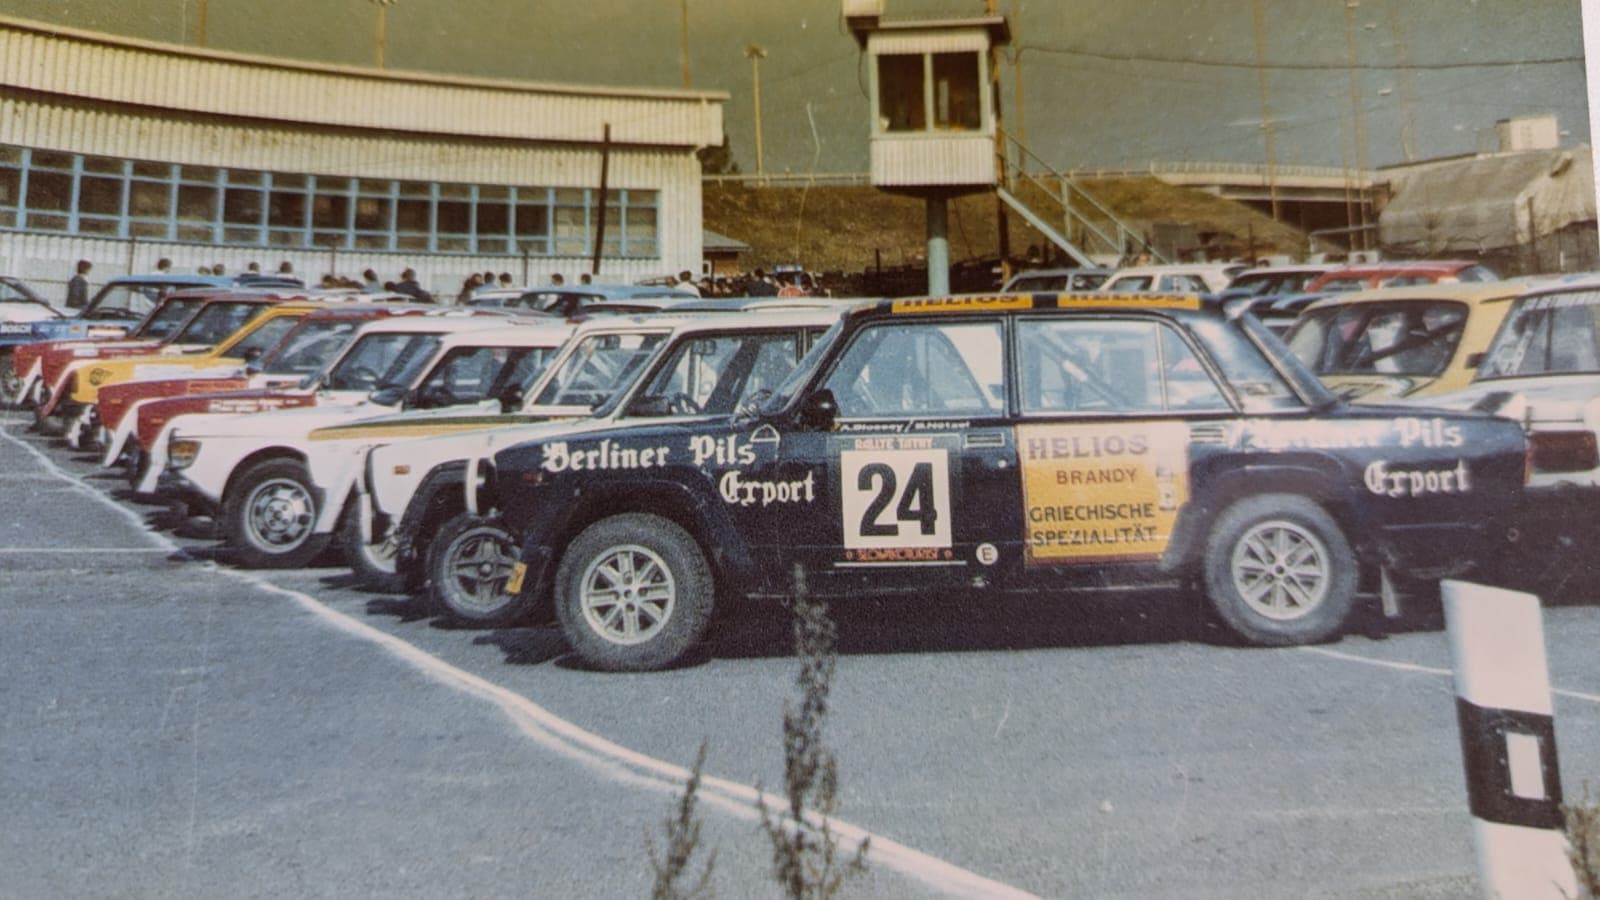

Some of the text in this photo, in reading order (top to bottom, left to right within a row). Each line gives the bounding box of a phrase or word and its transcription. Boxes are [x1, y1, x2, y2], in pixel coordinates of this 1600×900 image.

[1393, 417, 1463, 448] Pils
[542, 435, 756, 472] Berliner Pils
[1027, 435, 1148, 460] HELIOS
[1056, 468, 1137, 485] BRANDY
[858, 462, 937, 536] 24
[1029, 503, 1156, 522] GRIECHISCHE
[1032, 524, 1157, 546] SPEZIALITÄT
[982, 547, 993, 561] E
